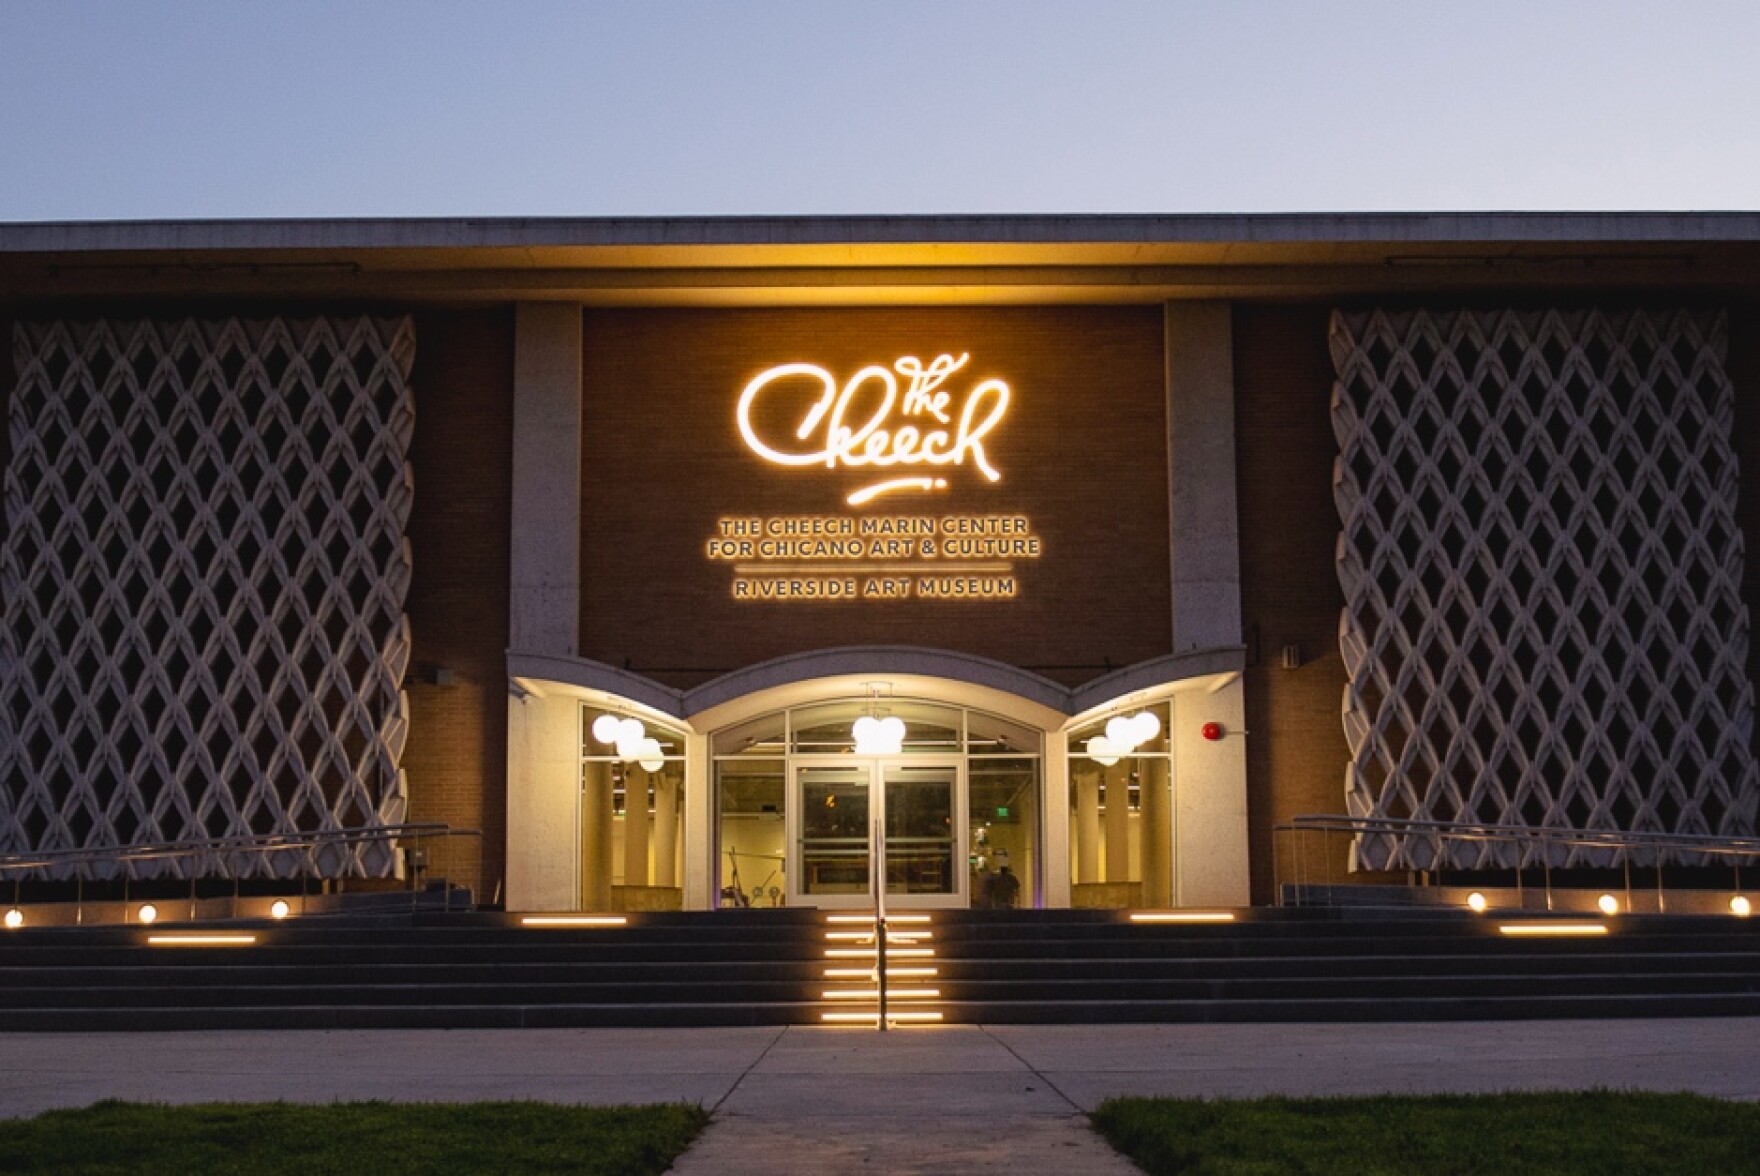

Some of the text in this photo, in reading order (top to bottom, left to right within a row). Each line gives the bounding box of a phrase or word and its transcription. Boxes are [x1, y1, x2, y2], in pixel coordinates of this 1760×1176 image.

[737, 363, 1010, 482] Cheech
[720, 518, 1027, 535] THE CHEECH MARIN CENTER
[709, 540, 1039, 556] FOR CHICANO ART & CULTURE
[735, 579, 1014, 595] RIVERSIDE ART MUSEUM
